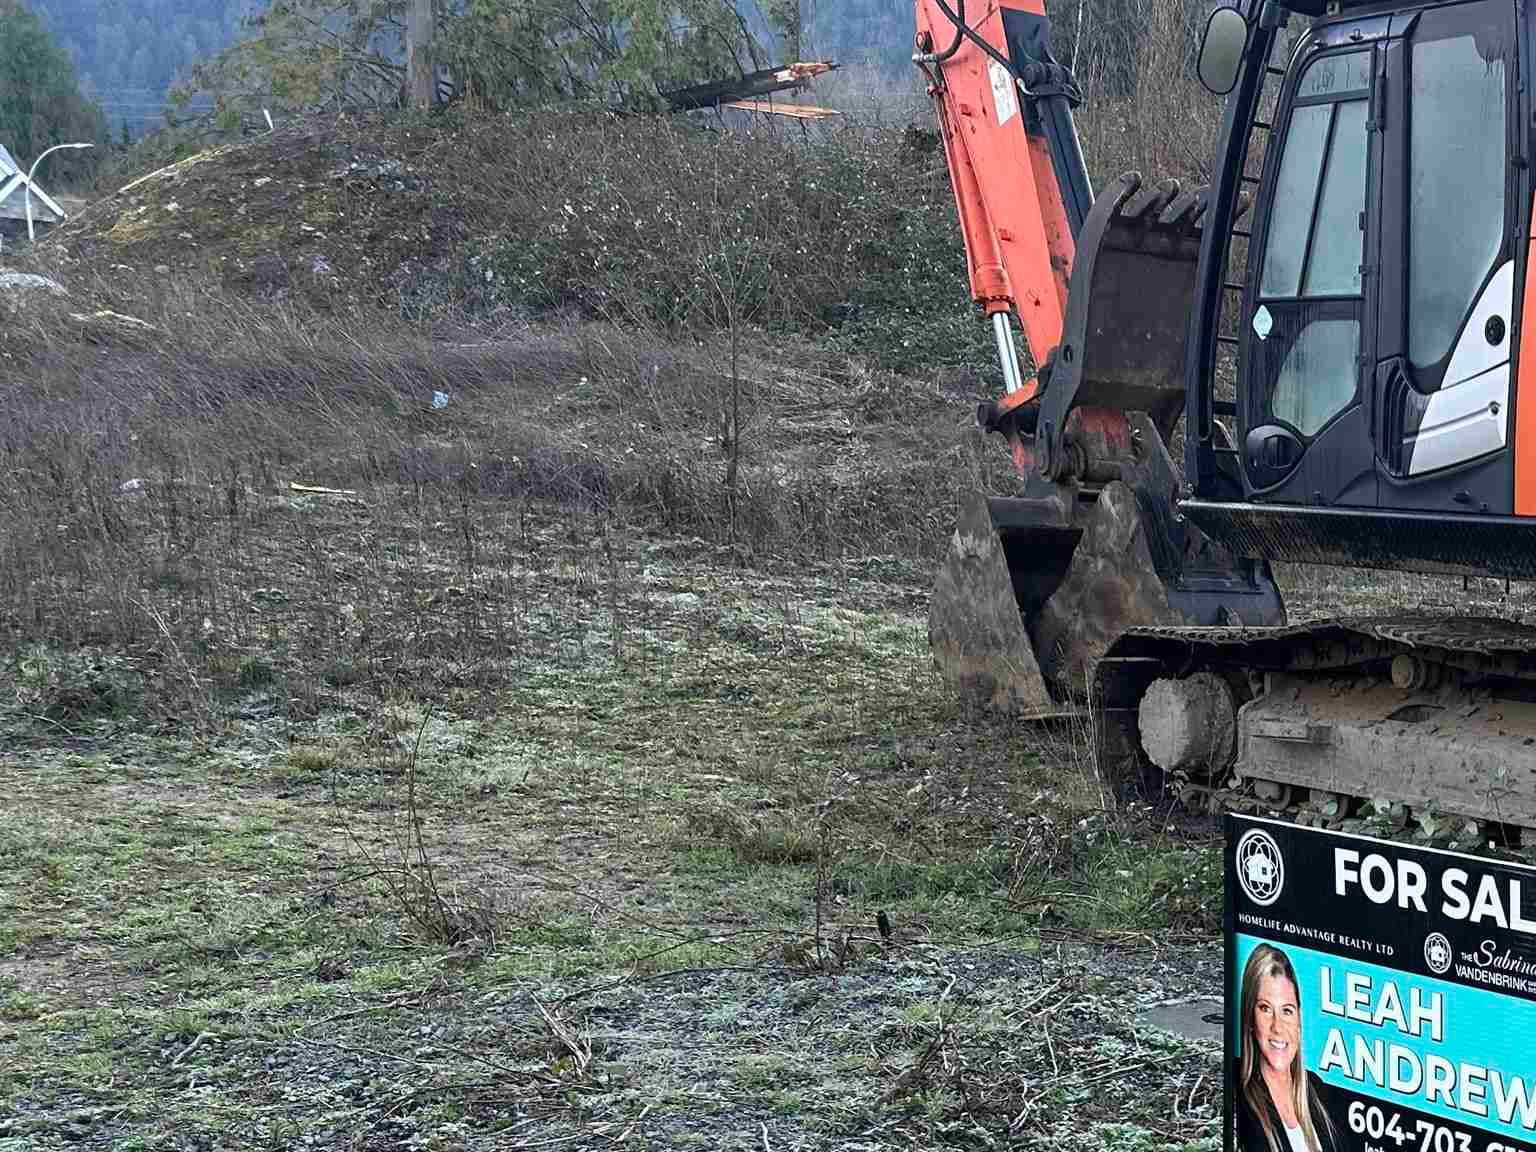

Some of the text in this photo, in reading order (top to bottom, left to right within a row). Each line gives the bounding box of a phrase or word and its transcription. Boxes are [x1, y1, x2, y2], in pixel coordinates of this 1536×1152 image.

[1334, 847, 1427, 913] FOR
[1238, 913, 1394, 956] HOMELIFE ADVANTAGE REALTY LTD
[1455, 963, 1527, 992] VANDENBRINK
[1461, 951, 1473, 962] THE
[1319, 965, 1445, 1042] LEAH
